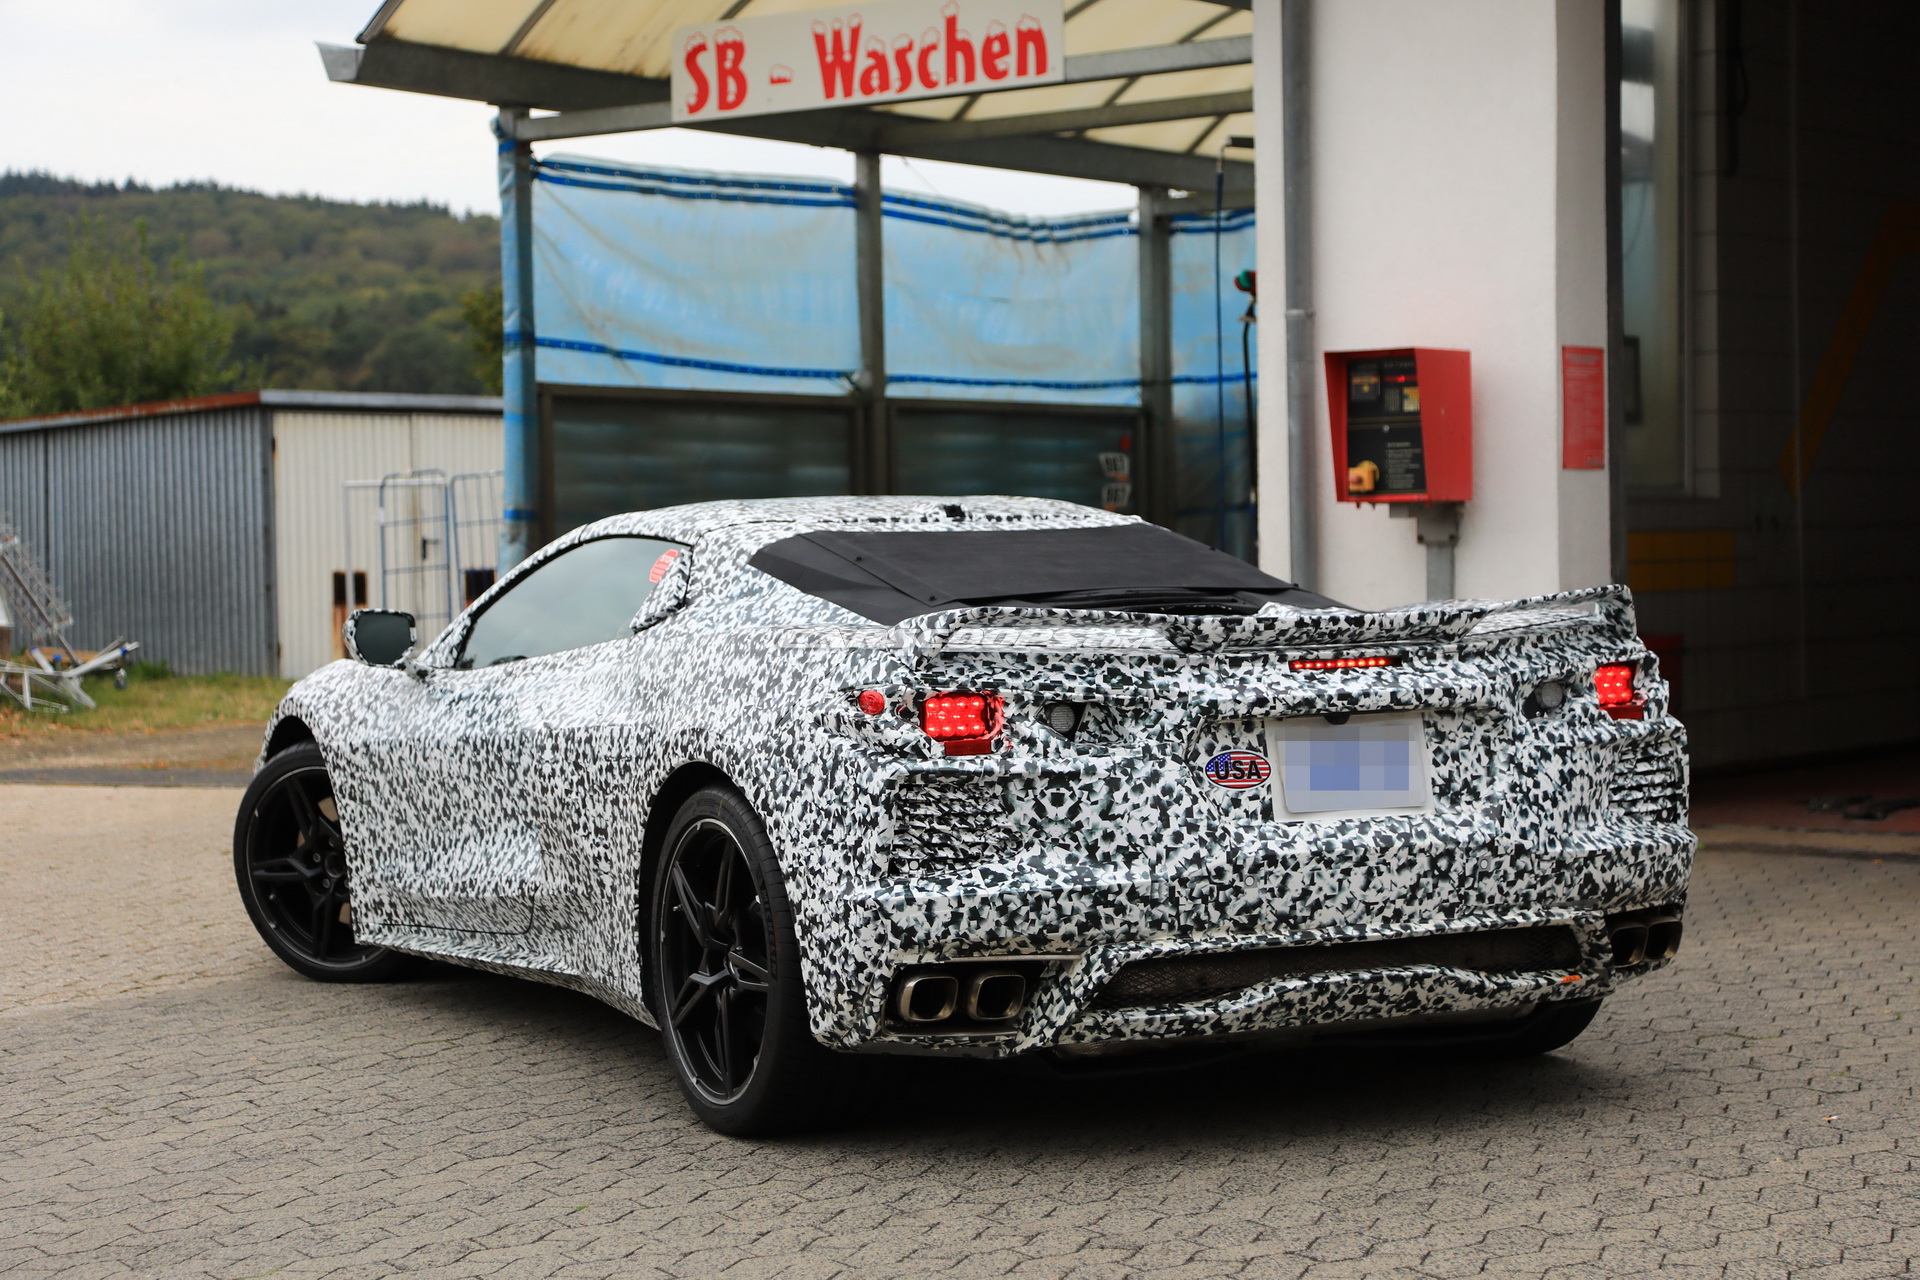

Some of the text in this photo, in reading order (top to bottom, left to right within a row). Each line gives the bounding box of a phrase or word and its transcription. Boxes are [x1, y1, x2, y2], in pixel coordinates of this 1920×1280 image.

[684, 26, 748, 115] SB
[811, 2, 1049, 99] Waschen
[1215, 760, 1262, 780] USA
[761, 888, 778, 976] MICHELIN
